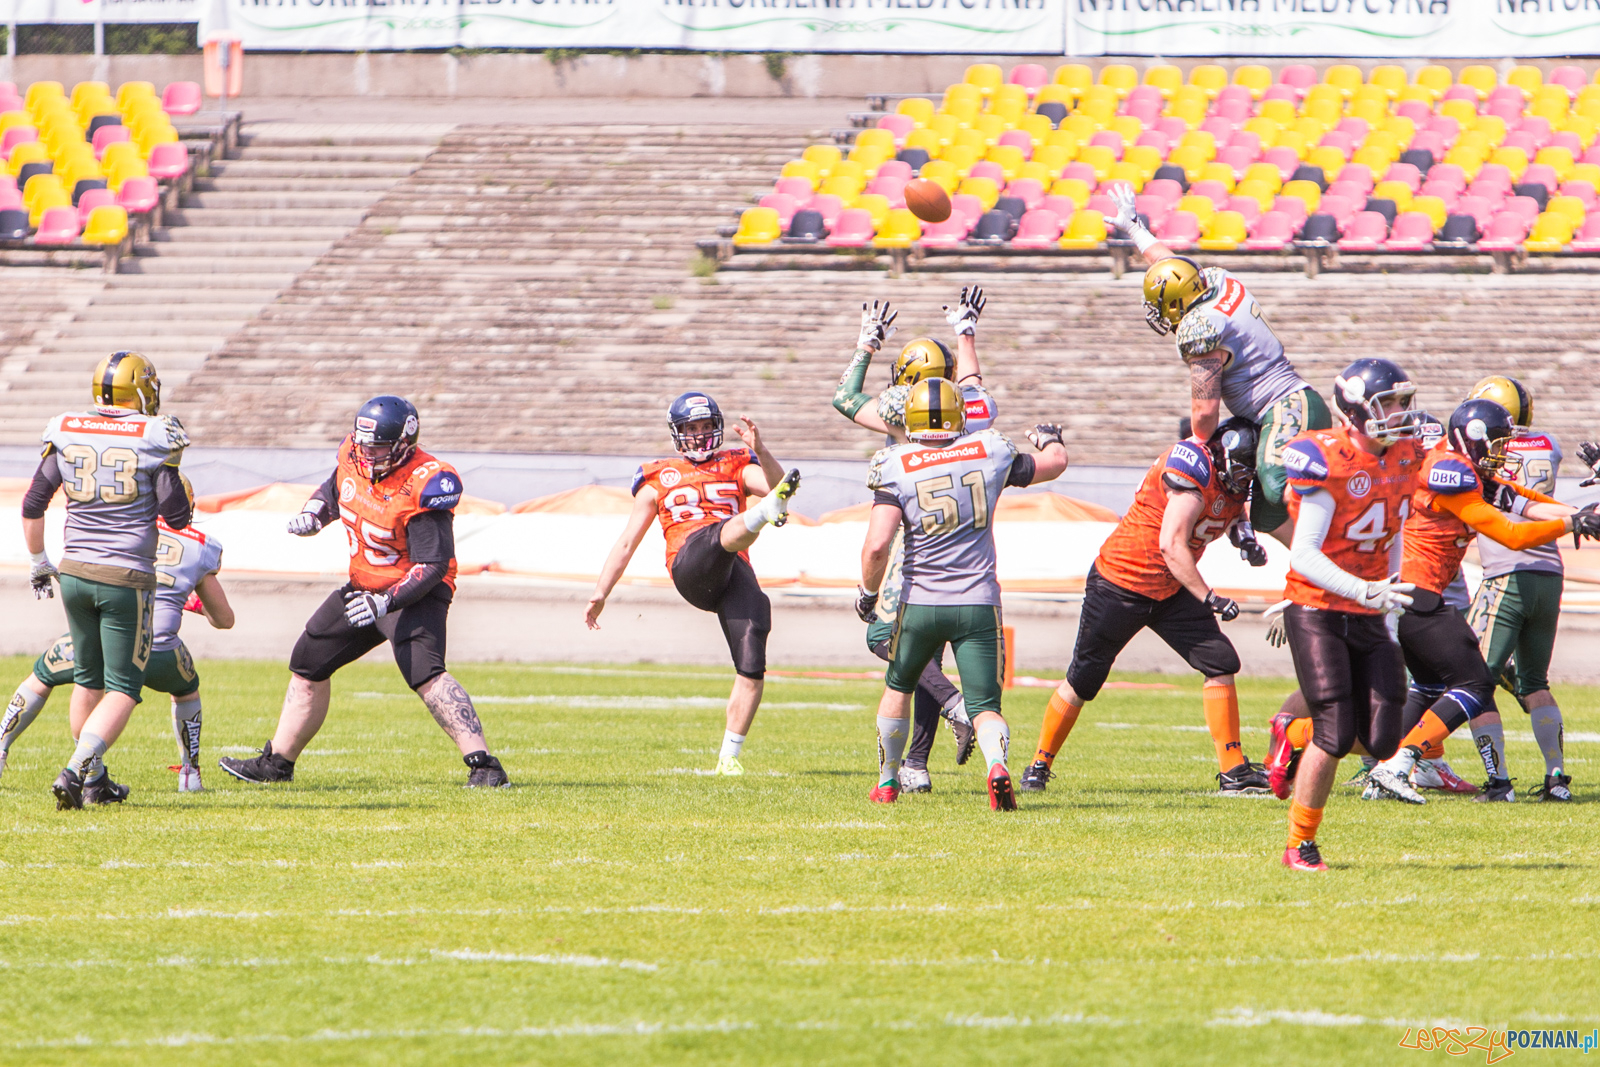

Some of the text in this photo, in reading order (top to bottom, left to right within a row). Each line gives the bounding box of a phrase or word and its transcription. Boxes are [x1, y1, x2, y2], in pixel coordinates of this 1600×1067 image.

[82, 419, 140, 433] Santander
[61, 444, 139, 504] 33
[922, 446, 979, 463] Santander
[1432, 471, 1457, 485] DBK
[663, 481, 740, 523] 85
[915, 470, 989, 536] 51
[338, 502, 403, 567] 55
[1189, 515, 1239, 550] 5
[1344, 494, 1412, 554] 41
